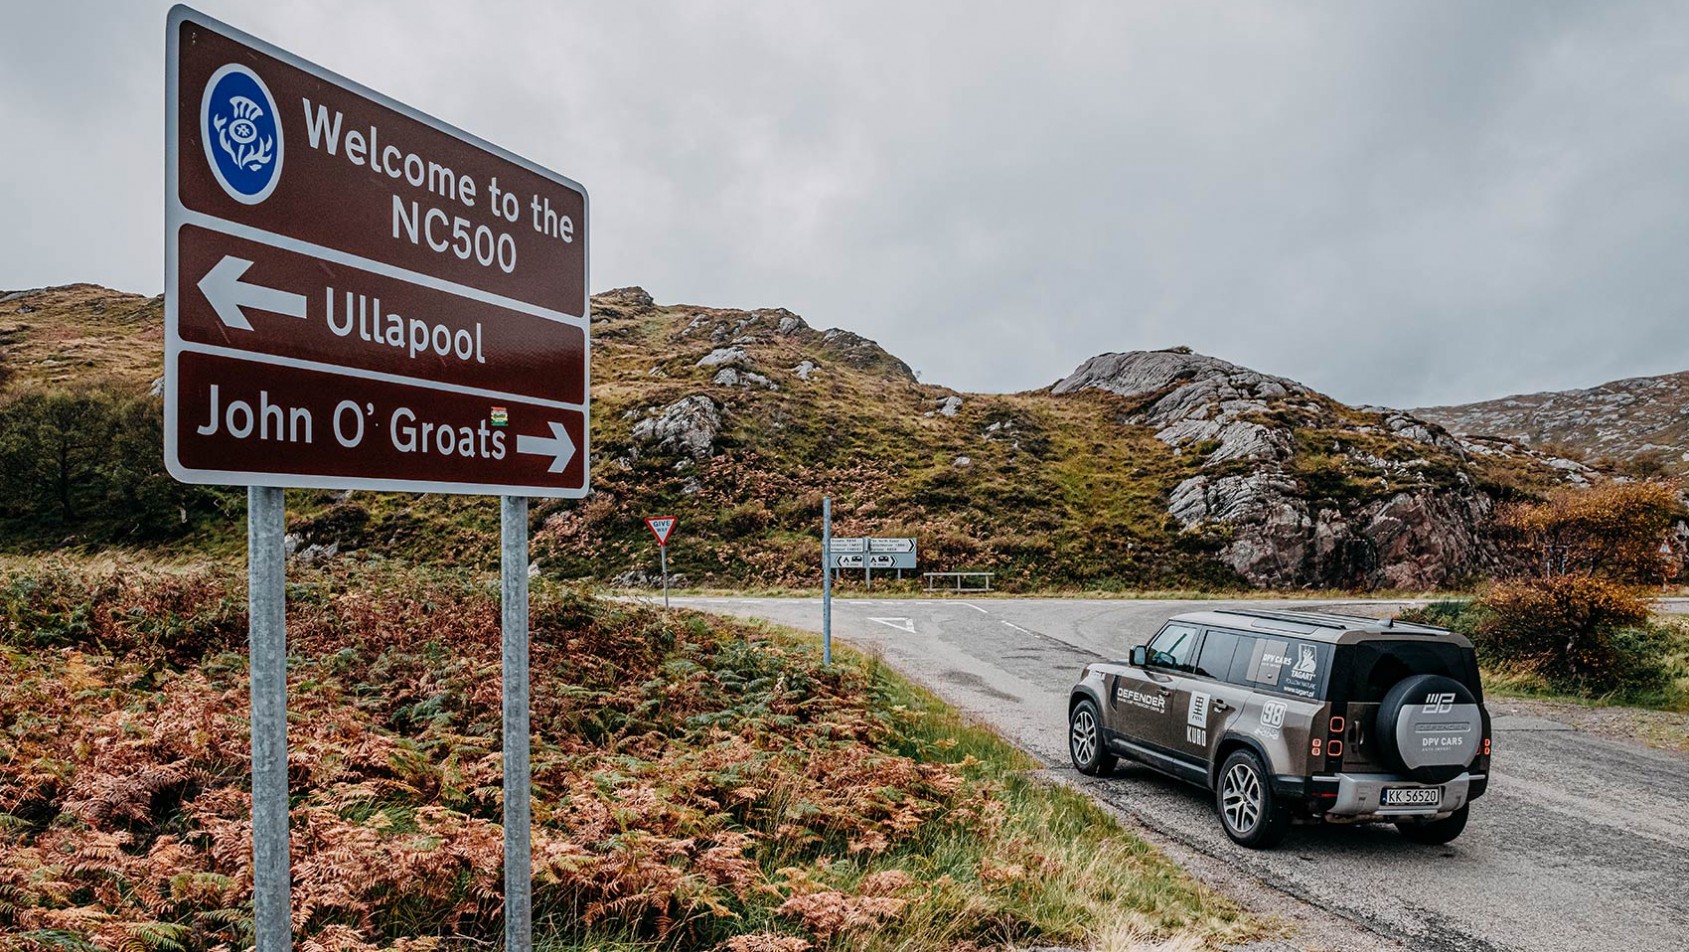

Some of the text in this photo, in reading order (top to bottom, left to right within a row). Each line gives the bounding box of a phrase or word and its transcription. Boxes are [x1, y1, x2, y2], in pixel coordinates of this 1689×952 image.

[302, 97, 574, 244] Welcome to the
[392, 195, 517, 273] NC500
[326, 286, 486, 364] Ullapool
[197, 384, 313, 444] John
[390, 407, 507, 460] Groats
[1117, 687, 1165, 709] DEFENDER
[1263, 702, 1285, 726] 98
[1187, 726, 1206, 747] KURO
[1422, 737, 1463, 746] DPV CARS
[1388, 790, 1437, 802] KK 56520
